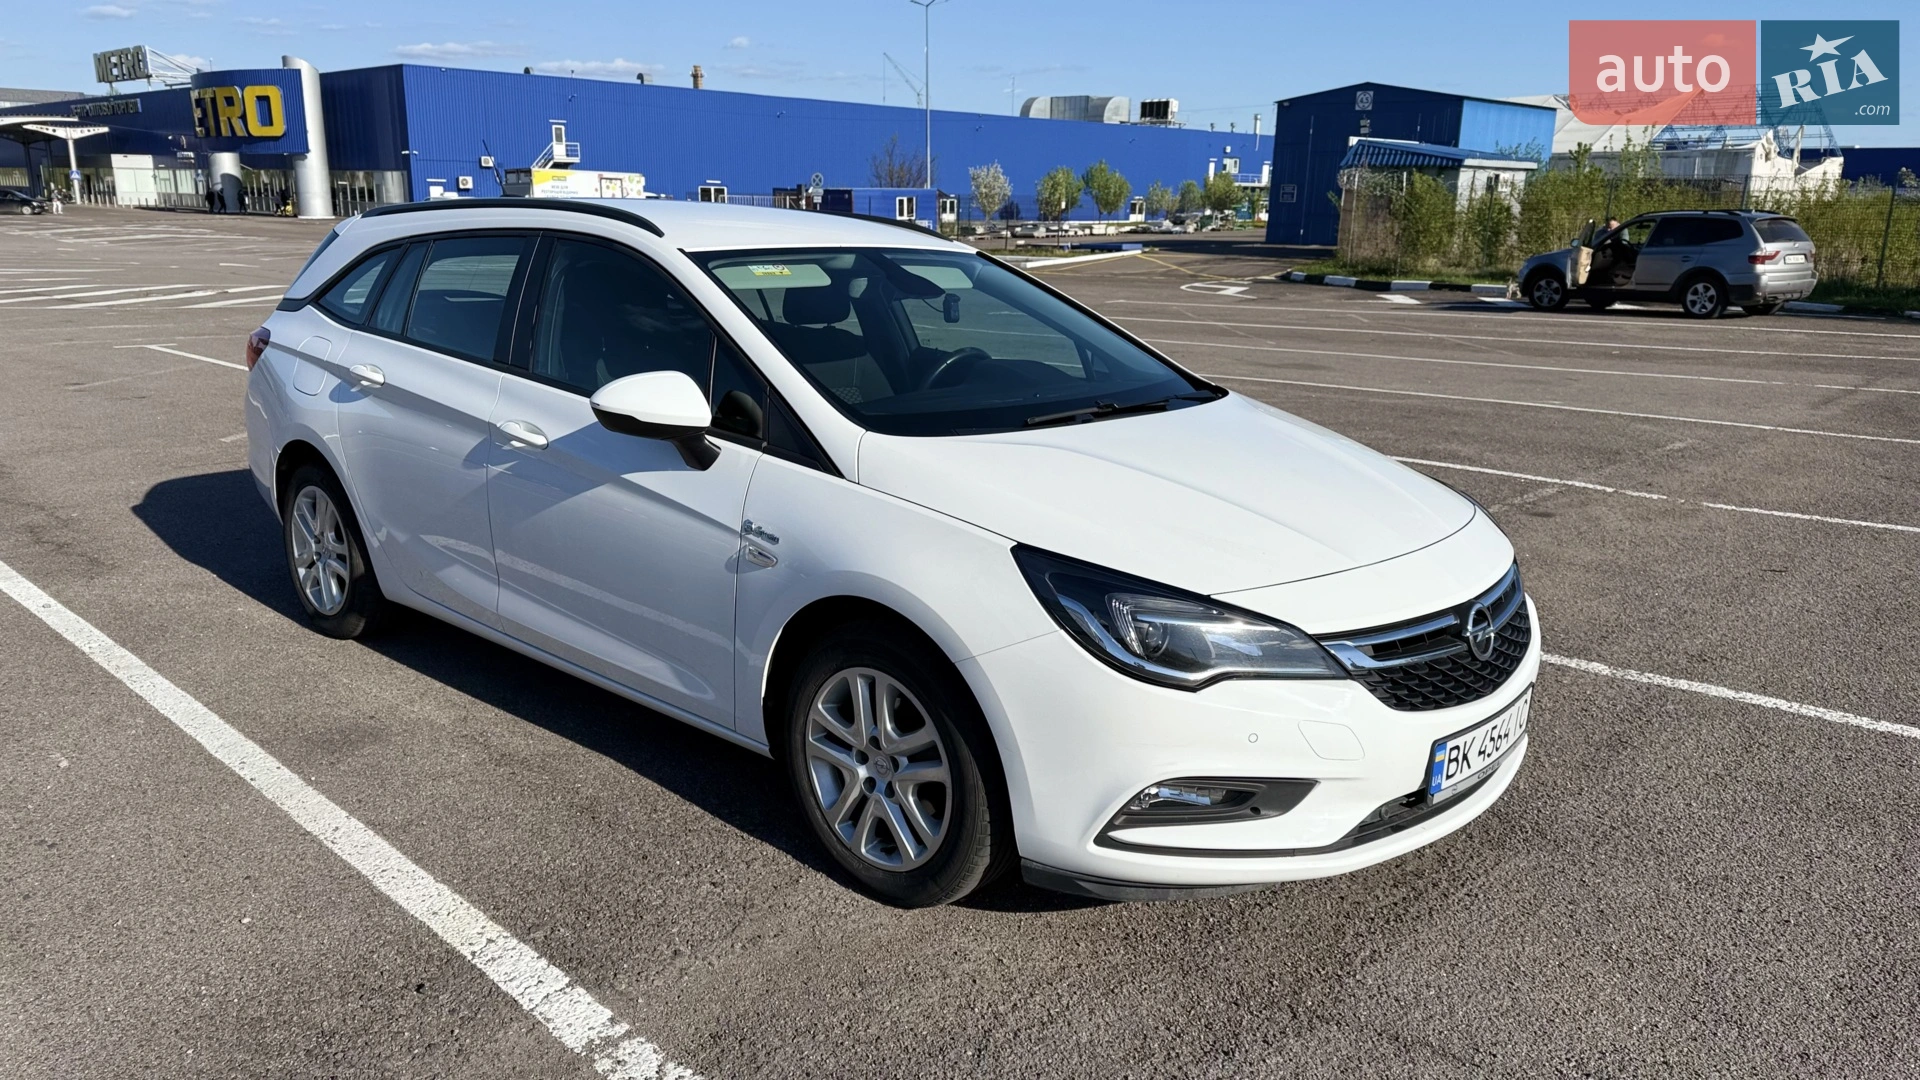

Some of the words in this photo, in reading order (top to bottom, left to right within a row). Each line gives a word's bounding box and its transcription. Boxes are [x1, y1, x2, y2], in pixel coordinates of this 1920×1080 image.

[93, 45, 146, 83] METRO
[190, 85, 286, 138] ETRO
[1445, 736, 1476, 781] BK
[1477, 712, 1513, 762] 4564
[1431, 773, 1442, 787] UA
